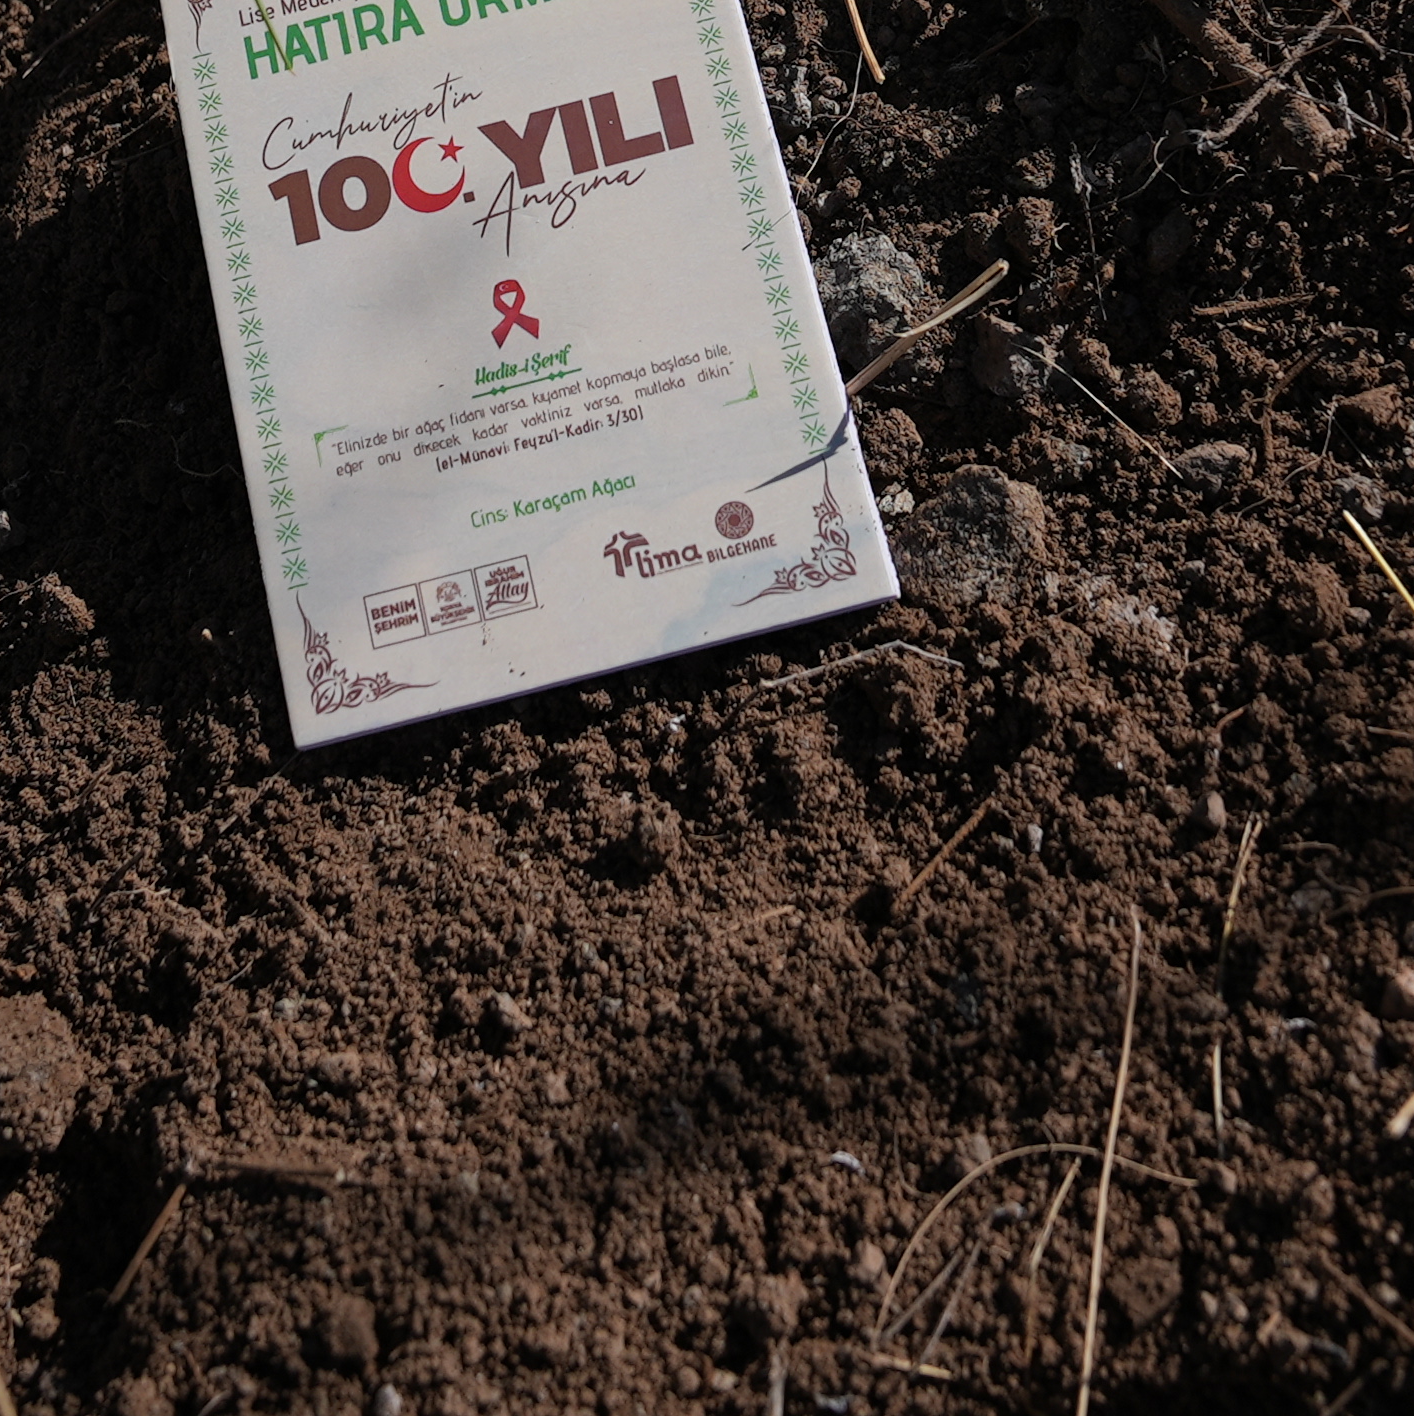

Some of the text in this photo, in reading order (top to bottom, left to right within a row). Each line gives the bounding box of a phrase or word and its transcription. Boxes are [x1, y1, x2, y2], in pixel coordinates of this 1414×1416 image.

[238, 5, 275, 27] Lise
[479, 74, 694, 190] YILI
[473, 166, 647, 258] Anısına
[530, 343, 572, 376] Şerif
[336, 460, 364, 477] eğer
[377, 450, 402, 466] onu
[413, 433, 462, 457] dikecek
[471, 422, 508, 442] kadar
[520, 406, 573, 429] vaktiniz
[634, 377, 686, 400] mutlaka
[391, 427, 410, 442] bir
[414, 418, 446, 437] ağaç
[449, 408, 486, 427] fidanı
[531, 380, 582, 405] kıyamet
[585, 366, 647, 391] kopmaya
[650, 352, 701, 375] başlasa
[606, 404, 644, 428] 3/30)
[470, 475, 636, 529] Cins: Karaçam Ağacı
